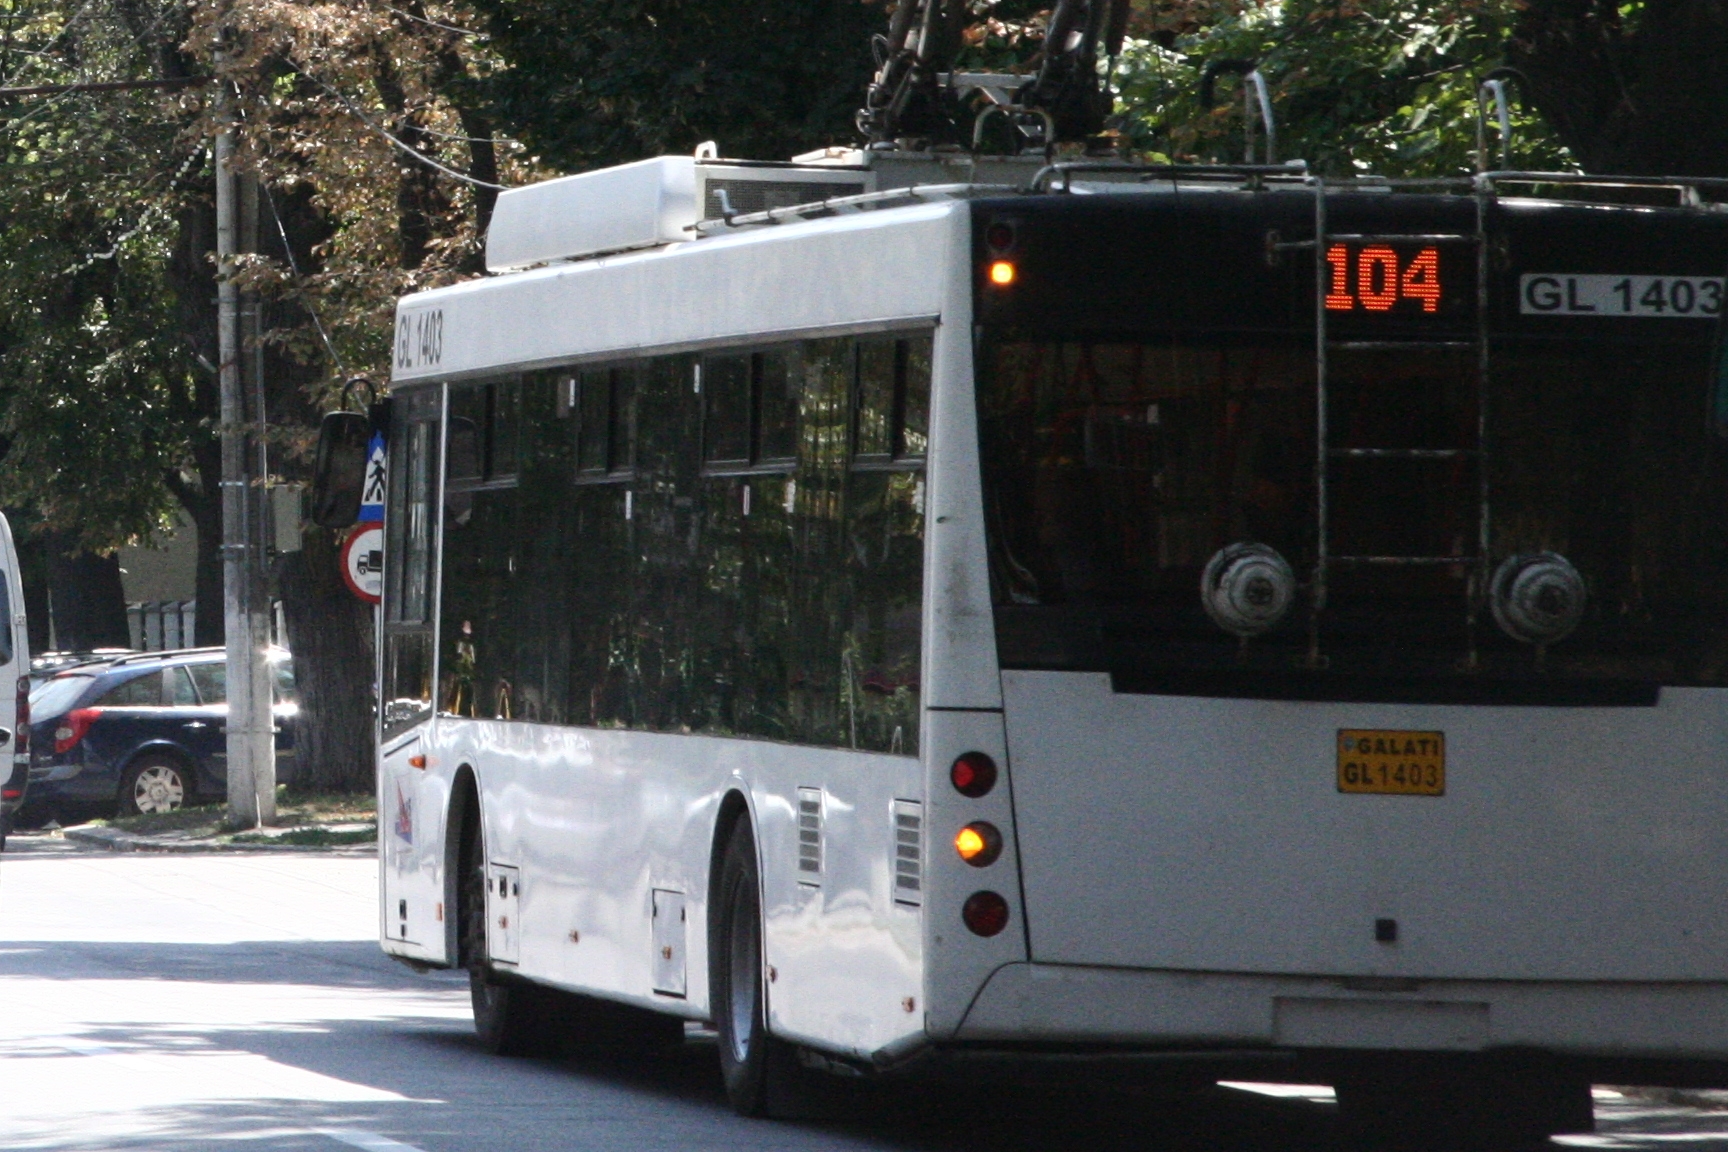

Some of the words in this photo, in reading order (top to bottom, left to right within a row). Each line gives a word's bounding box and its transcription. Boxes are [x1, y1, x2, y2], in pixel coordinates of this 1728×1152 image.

[1325, 243, 1440, 311] 104
[1527, 276, 1595, 312] GL
[1613, 279, 1723, 314] 1403
[398, 314, 412, 368] GL
[417, 309, 443, 367] 1403
[1344, 762, 1373, 784] GL
[1378, 764, 1438, 786] 1403
